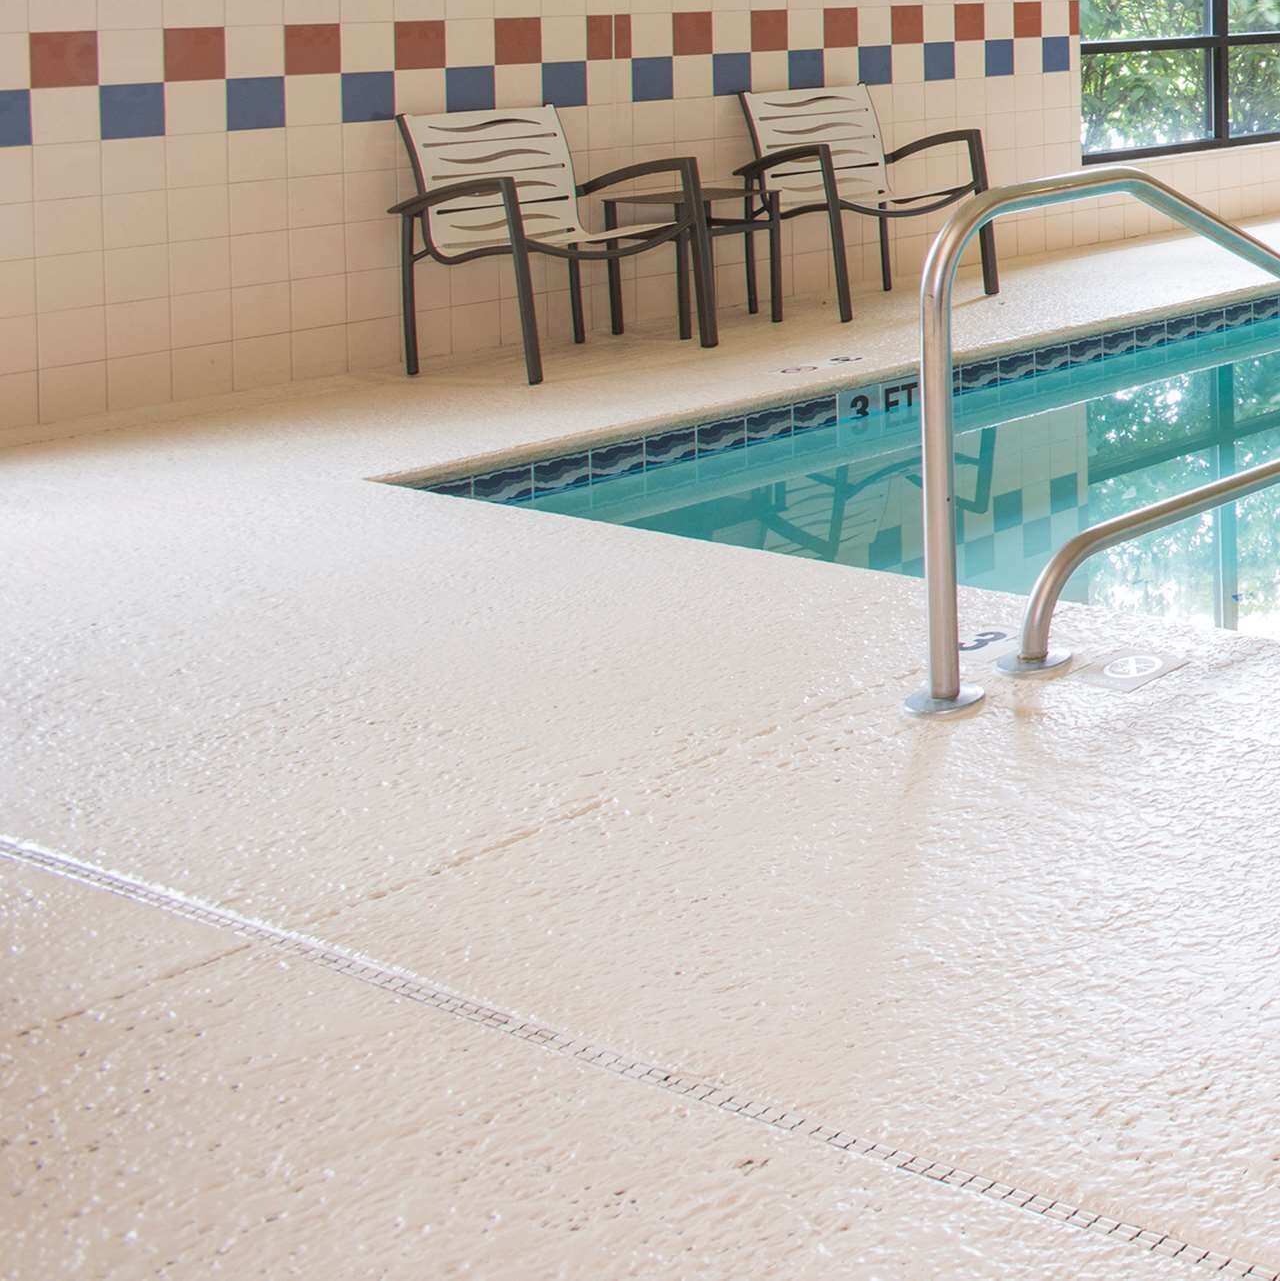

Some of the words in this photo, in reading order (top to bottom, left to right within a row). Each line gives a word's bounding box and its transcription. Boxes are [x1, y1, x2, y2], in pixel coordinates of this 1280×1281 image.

[850, 395, 869, 416] 3
[884, 382, 918, 413] FT
[958, 631, 1008, 651] 3
